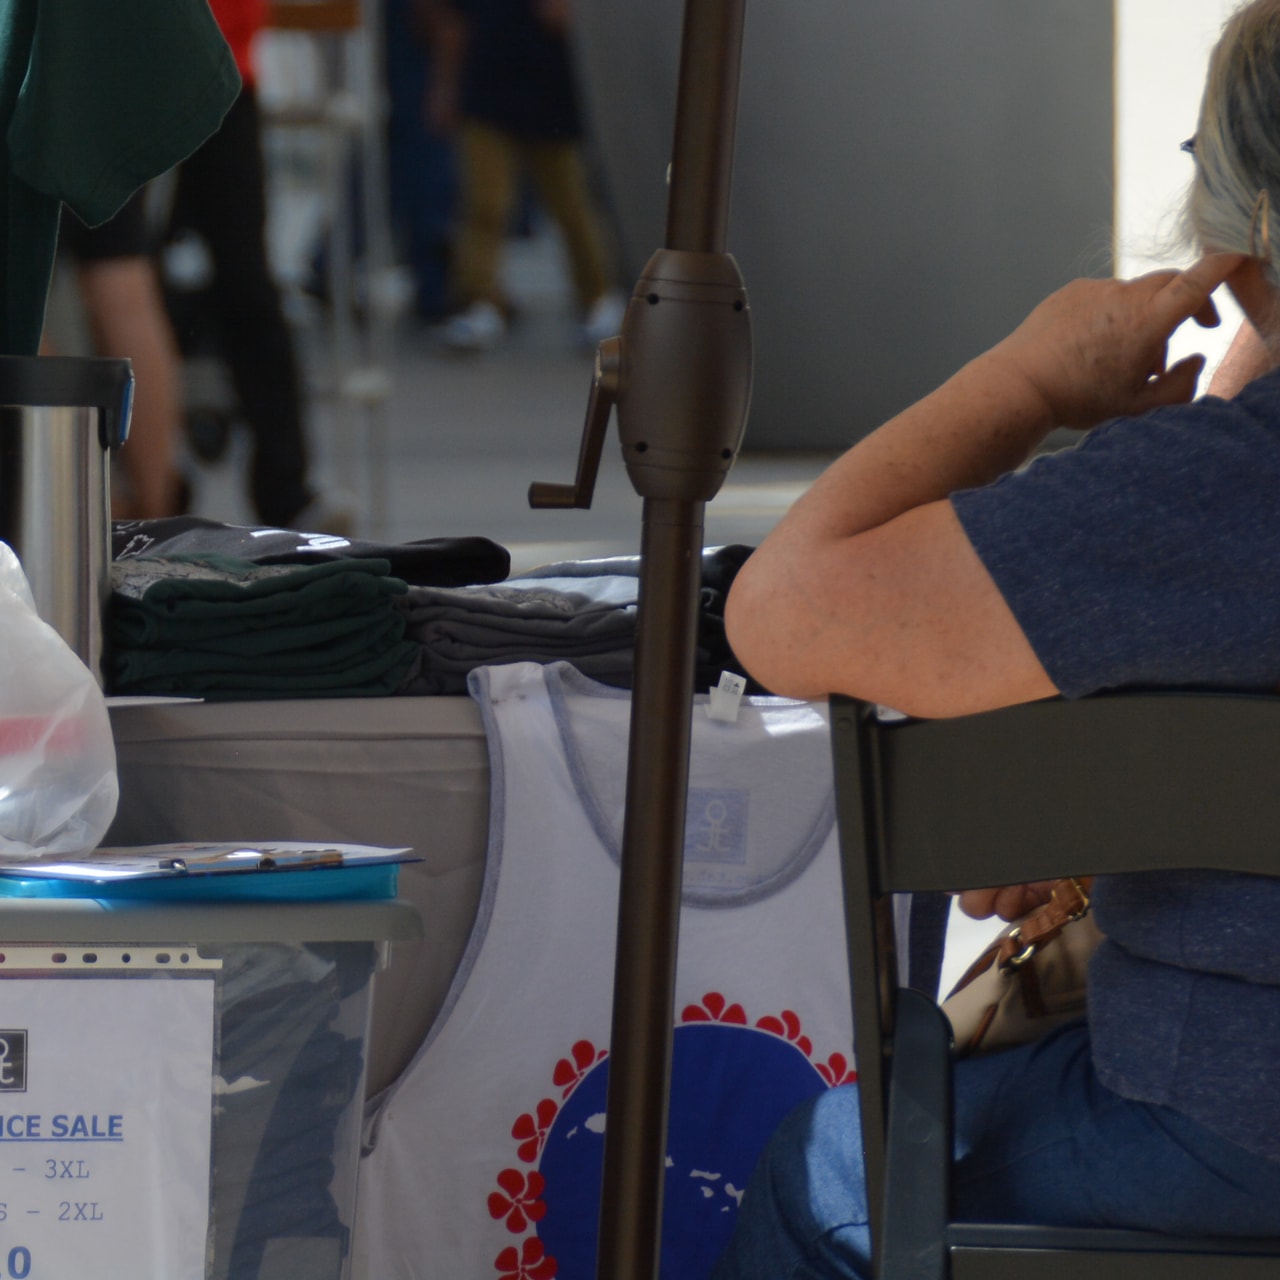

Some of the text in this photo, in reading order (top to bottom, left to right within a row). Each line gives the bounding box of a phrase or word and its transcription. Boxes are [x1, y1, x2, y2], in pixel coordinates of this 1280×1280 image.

[51, 1114, 124, 1137] SALE
[44, 1159, 90, 1179] 3XL
[58, 1202, 104, 1221] 2XL
